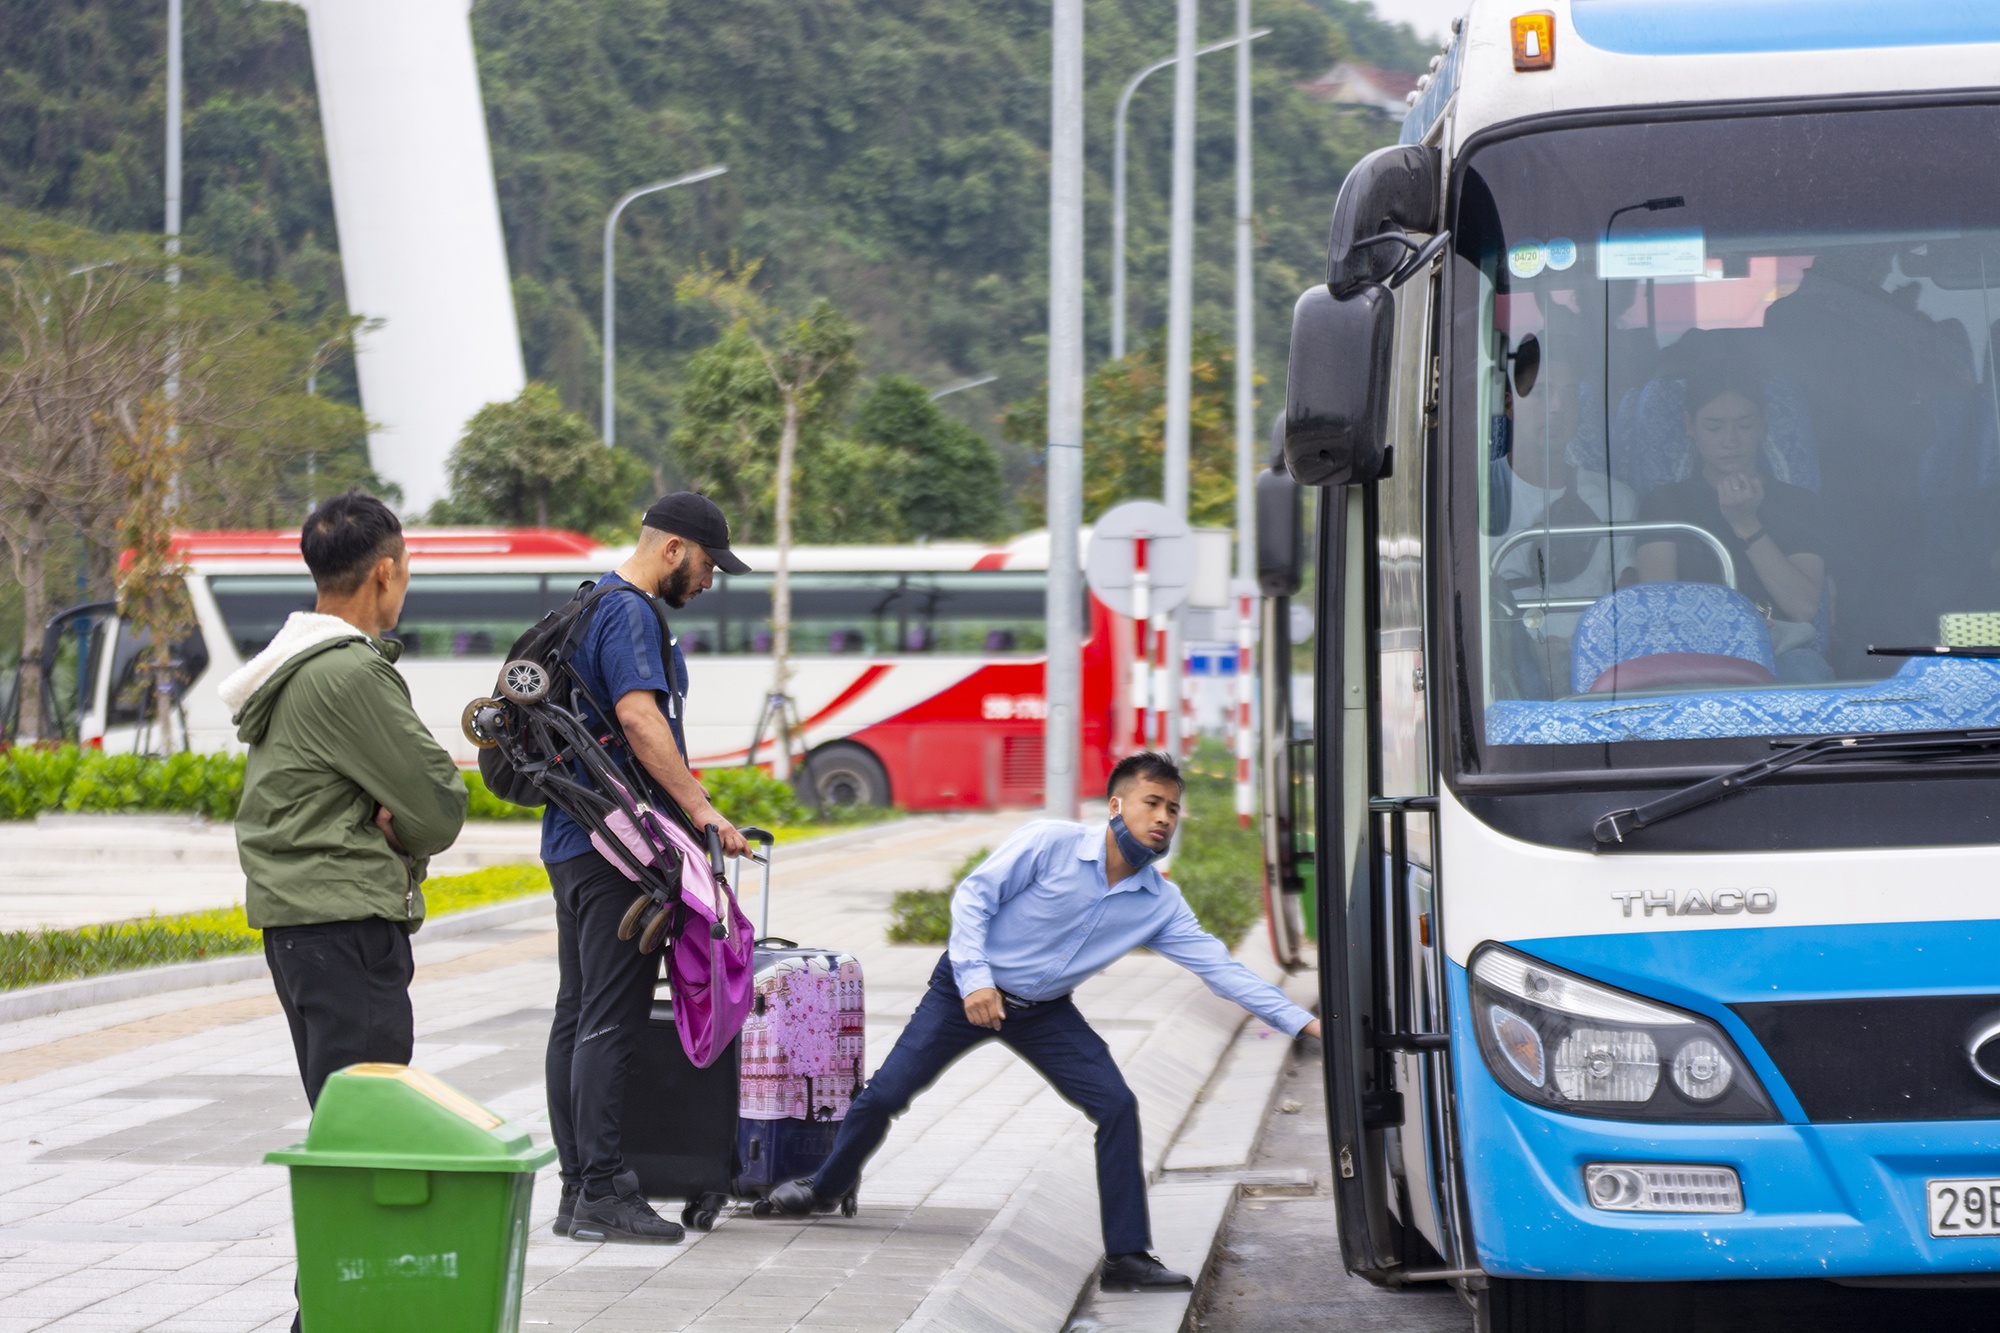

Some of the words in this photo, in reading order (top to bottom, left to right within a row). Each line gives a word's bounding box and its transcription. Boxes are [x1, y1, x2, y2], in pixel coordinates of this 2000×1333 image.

[1514, 251, 1537, 262] 04/20
[1550, 246, 1571, 256] 04/20
[1611, 886, 1777, 917] THACO
[581, 1032, 599, 1043] UNDER
